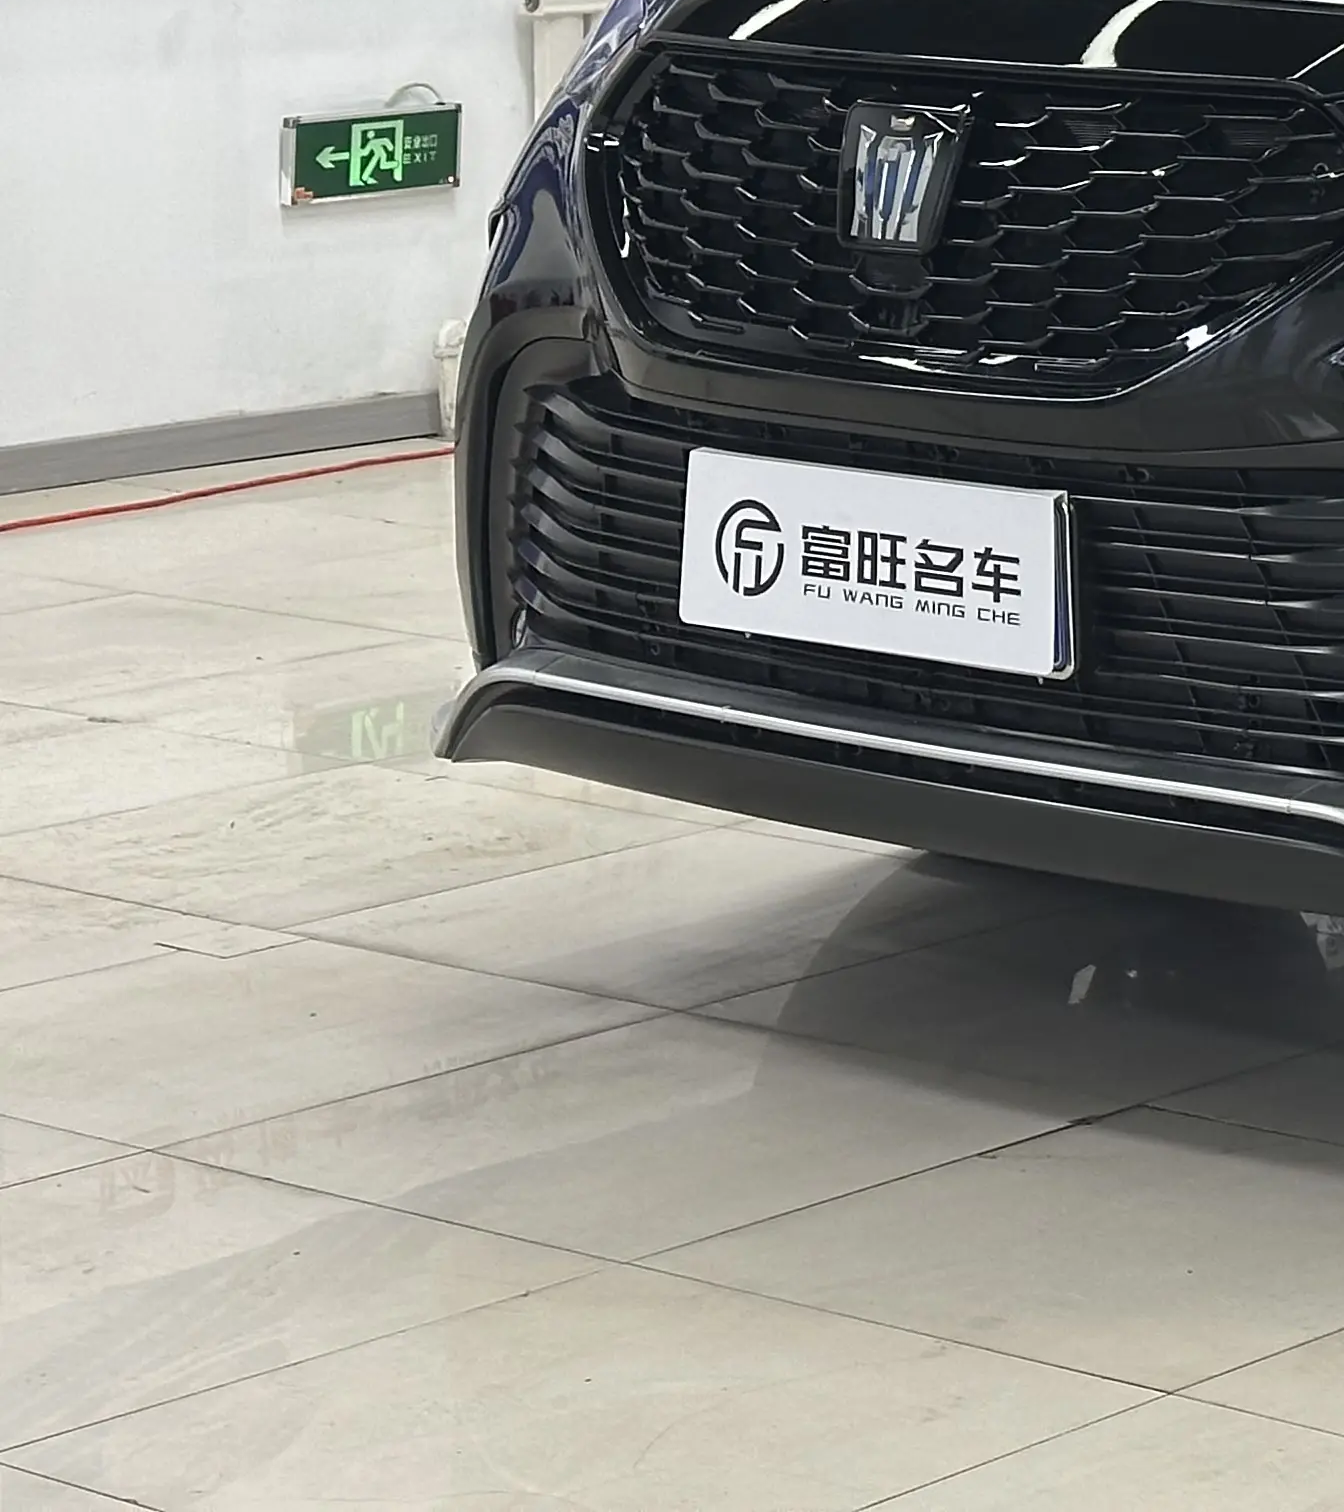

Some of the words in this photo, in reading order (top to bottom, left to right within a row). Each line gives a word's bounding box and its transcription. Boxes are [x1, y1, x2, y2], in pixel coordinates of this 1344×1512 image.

[403, 150, 437, 165] EXIT
[801, 524, 1022, 604] 富旺名车
[803, 584, 831, 600] FU
[843, 588, 904, 610] WANG
[914, 599, 966, 619] MING
[976, 607, 1021, 627] CHE
